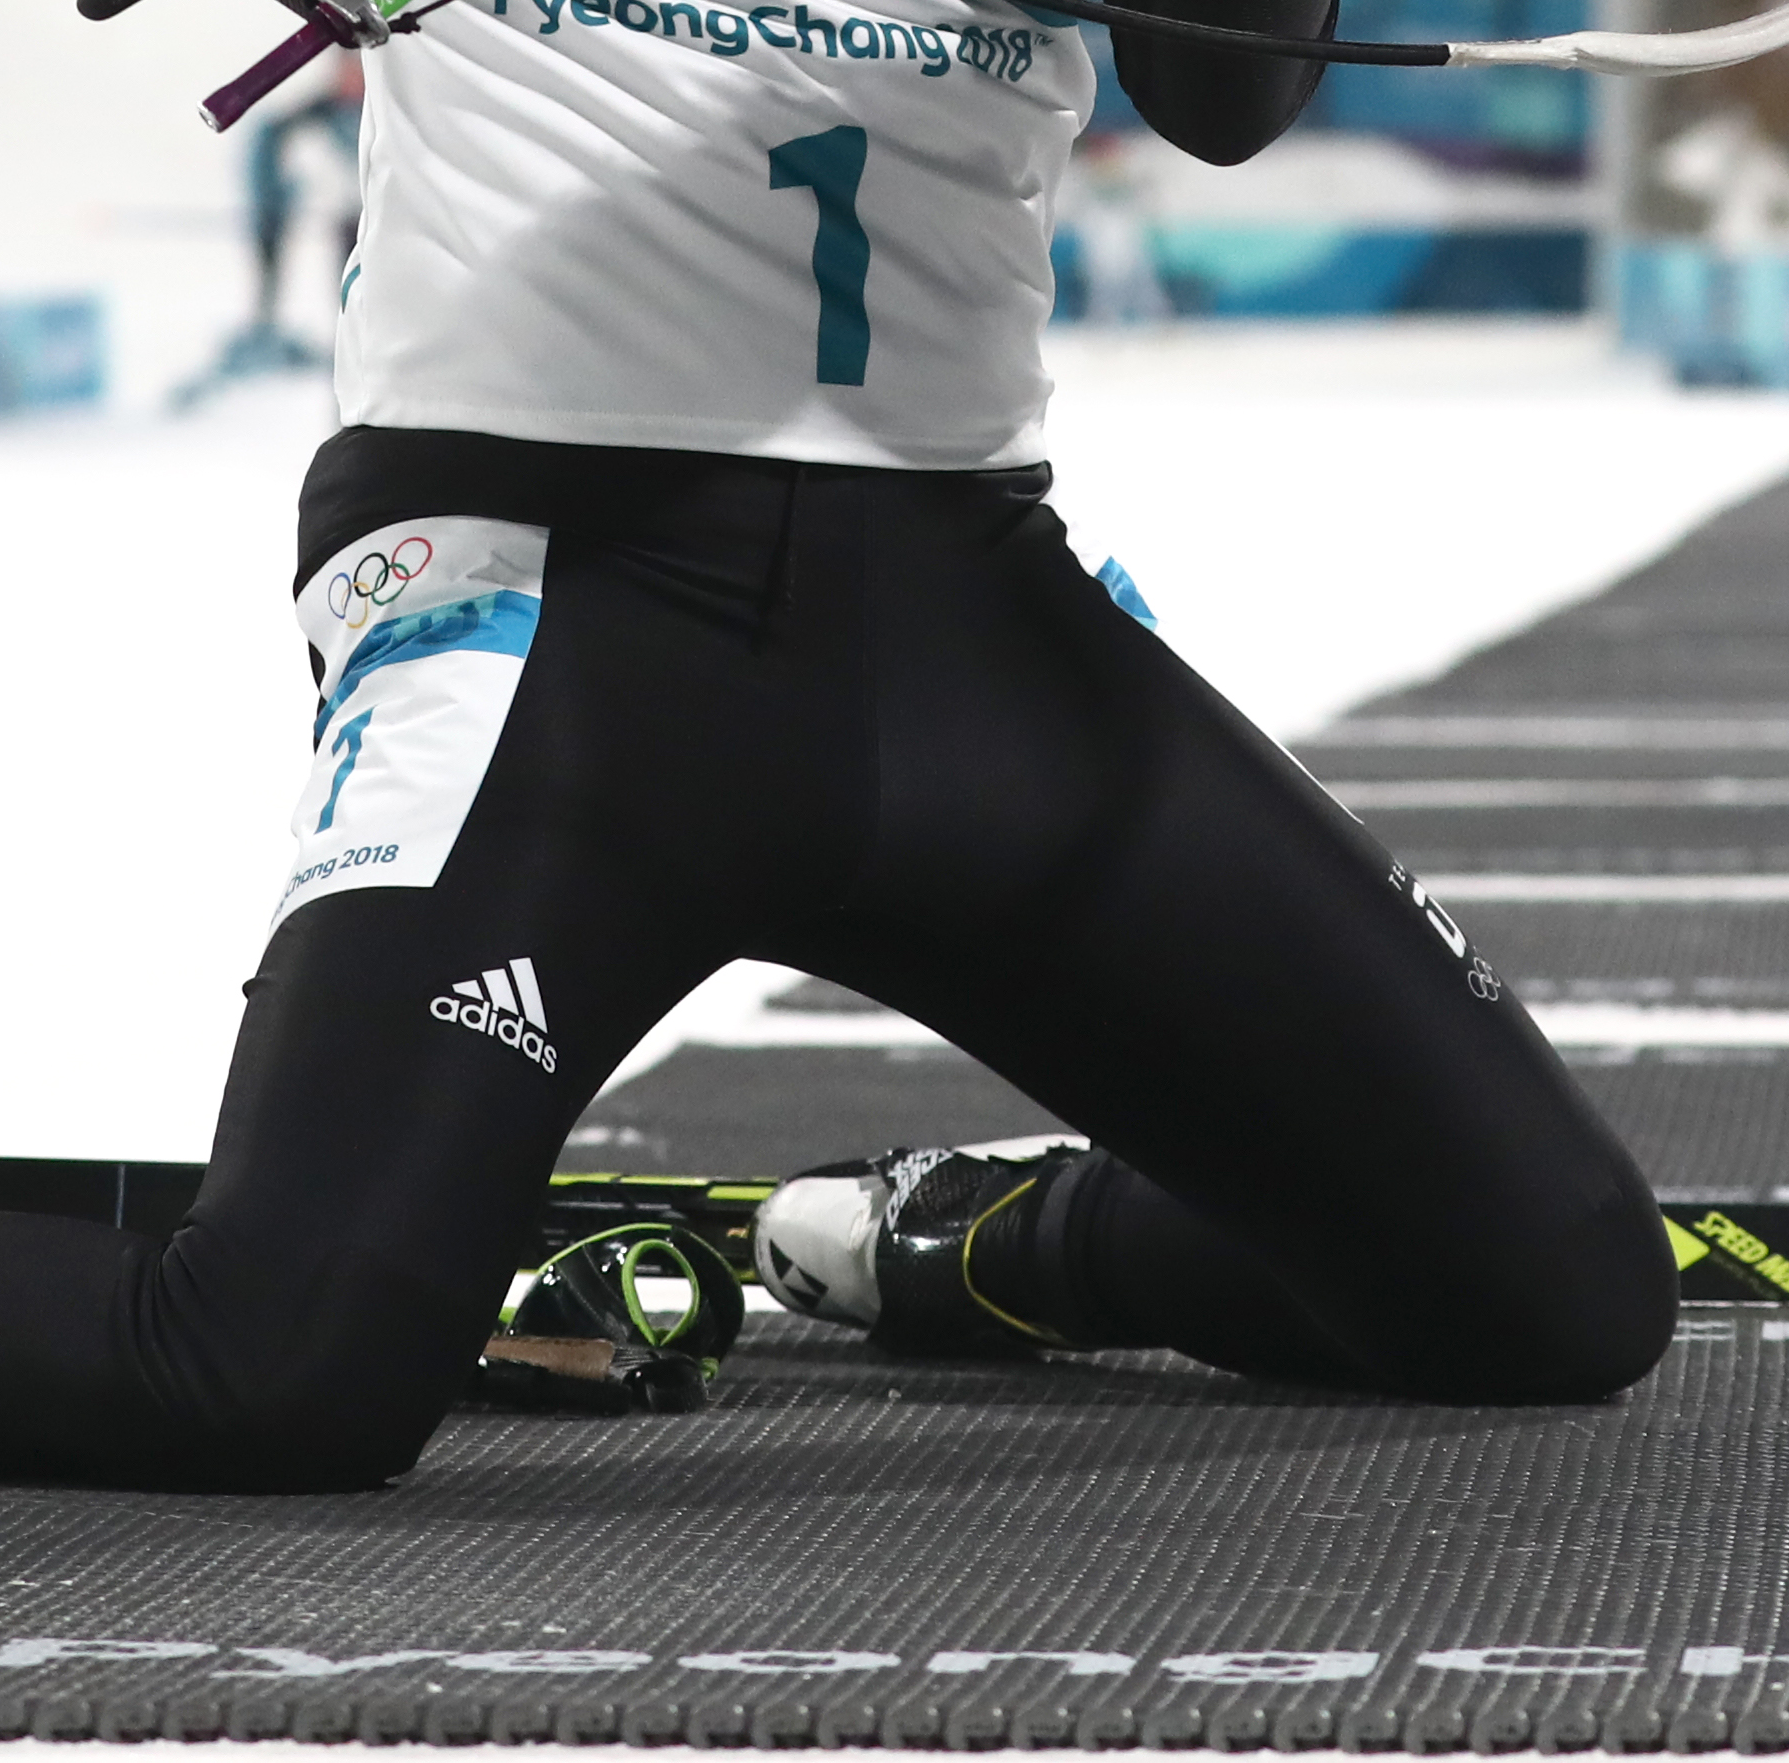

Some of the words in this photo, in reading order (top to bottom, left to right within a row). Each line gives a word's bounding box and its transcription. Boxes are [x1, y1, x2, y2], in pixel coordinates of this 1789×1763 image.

[768, 125, 871, 387] 1
[314, 706, 375, 836] 1
[339, 843, 399, 870] 2018
[430, 995, 557, 1074] adidas
[1693, 1211, 1770, 1264] SPEED
